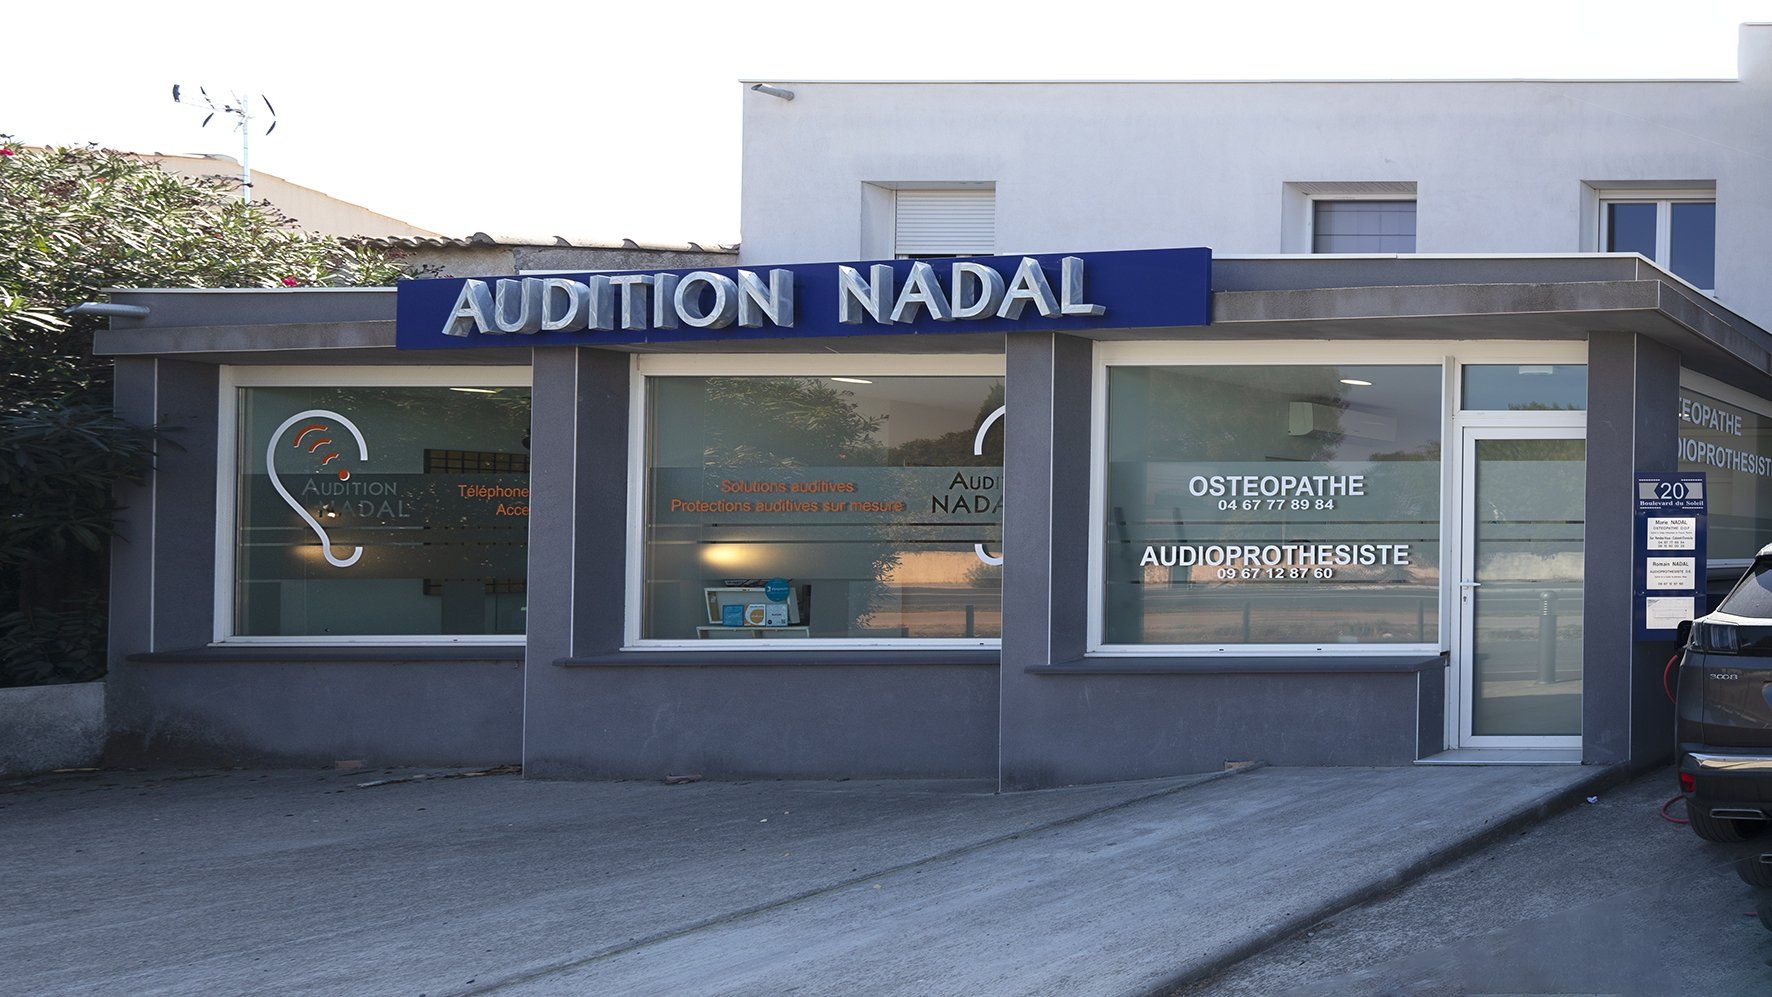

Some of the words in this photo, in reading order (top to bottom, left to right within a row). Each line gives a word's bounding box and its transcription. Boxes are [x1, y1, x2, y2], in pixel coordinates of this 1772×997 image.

[441, 268, 795, 337] AUDITION
[838, 256, 1107, 325] NADAL
[1679, 397, 1742, 437] EOPATHE
[1678, 437, 1772, 477] IOPROTHESIST
[458, 484, 529, 500] Téléphone
[721, 480, 787, 493] Solutions
[791, 480, 855, 493] auditives
[1188, 475, 1365, 497] OSTEOPATHE
[1660, 482, 1684, 500] 20
[496, 503, 529, 516] Acce
[671, 498, 751, 512] Protections
[755, 499, 818, 512] auditives
[823, 501, 845, 512] sur
[849, 501, 904, 512] mesure
[1218, 499, 1237, 511] 04
[1242, 499, 1262, 511] 67
[1267, 499, 1286, 511] 77
[1290, 499, 1310, 511] 89
[1314, 499, 1335, 511] 84
[1140, 544, 1410, 567] AUDIOPROTHESISTE
[1217, 567, 1236, 579] 09
[1241, 567, 1260, 579] 67
[1266, 567, 1285, 579] 12
[1289, 567, 1308, 579] 87
[1313, 567, 1333, 579] 60
